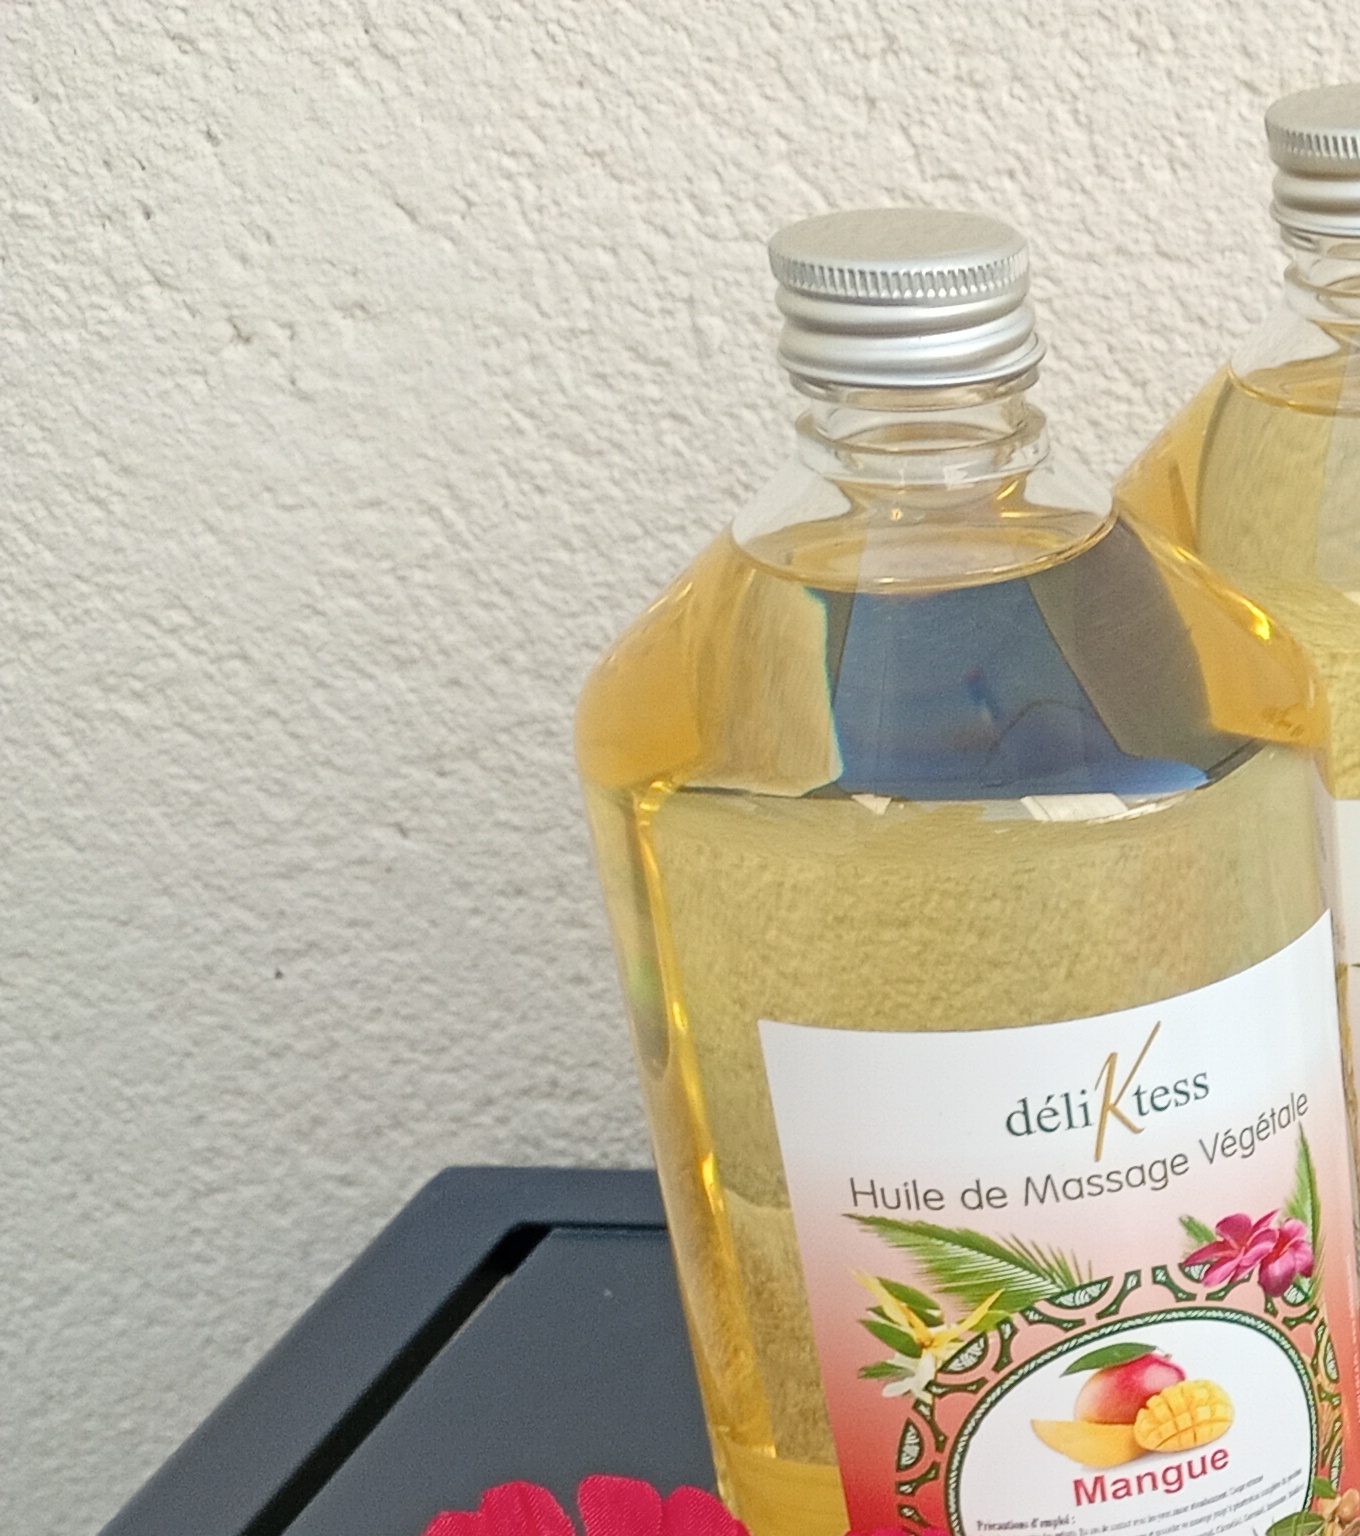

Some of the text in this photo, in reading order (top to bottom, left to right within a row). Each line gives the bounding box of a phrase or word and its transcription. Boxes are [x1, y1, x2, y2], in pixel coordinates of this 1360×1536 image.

[849, 1089, 1309, 1212] Huile de Massage Végétale
[1004, 1021, 1210, 1161] déliKtess
[1073, 1445, 1230, 1508] Mangue
